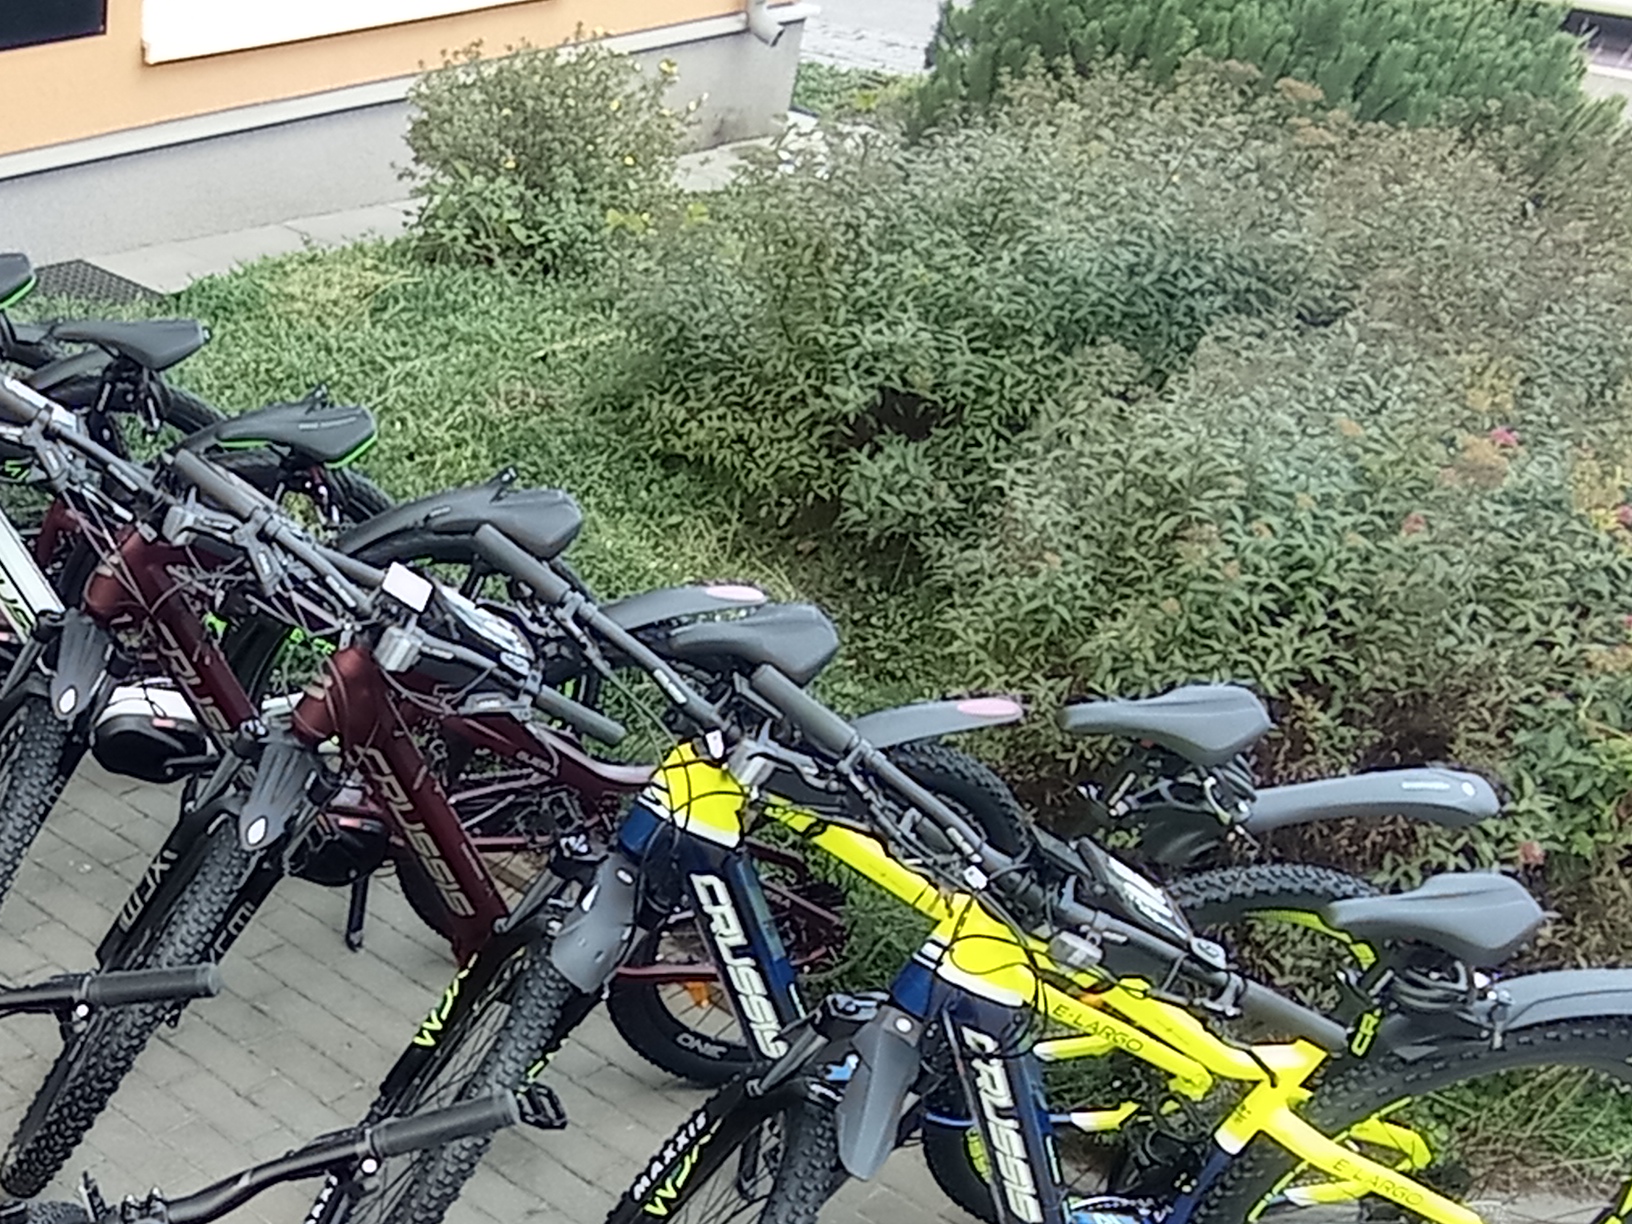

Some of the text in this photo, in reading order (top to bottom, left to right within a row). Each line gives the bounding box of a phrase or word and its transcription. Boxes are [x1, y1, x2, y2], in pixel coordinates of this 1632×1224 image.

[689, 873, 789, 1060] CRUSSIS
[1052, 1002, 1145, 1053] E-LARGO
[633, 1111, 707, 1201] MAXXIS
[961, 1024, 1045, 1224] CRUSSIS
